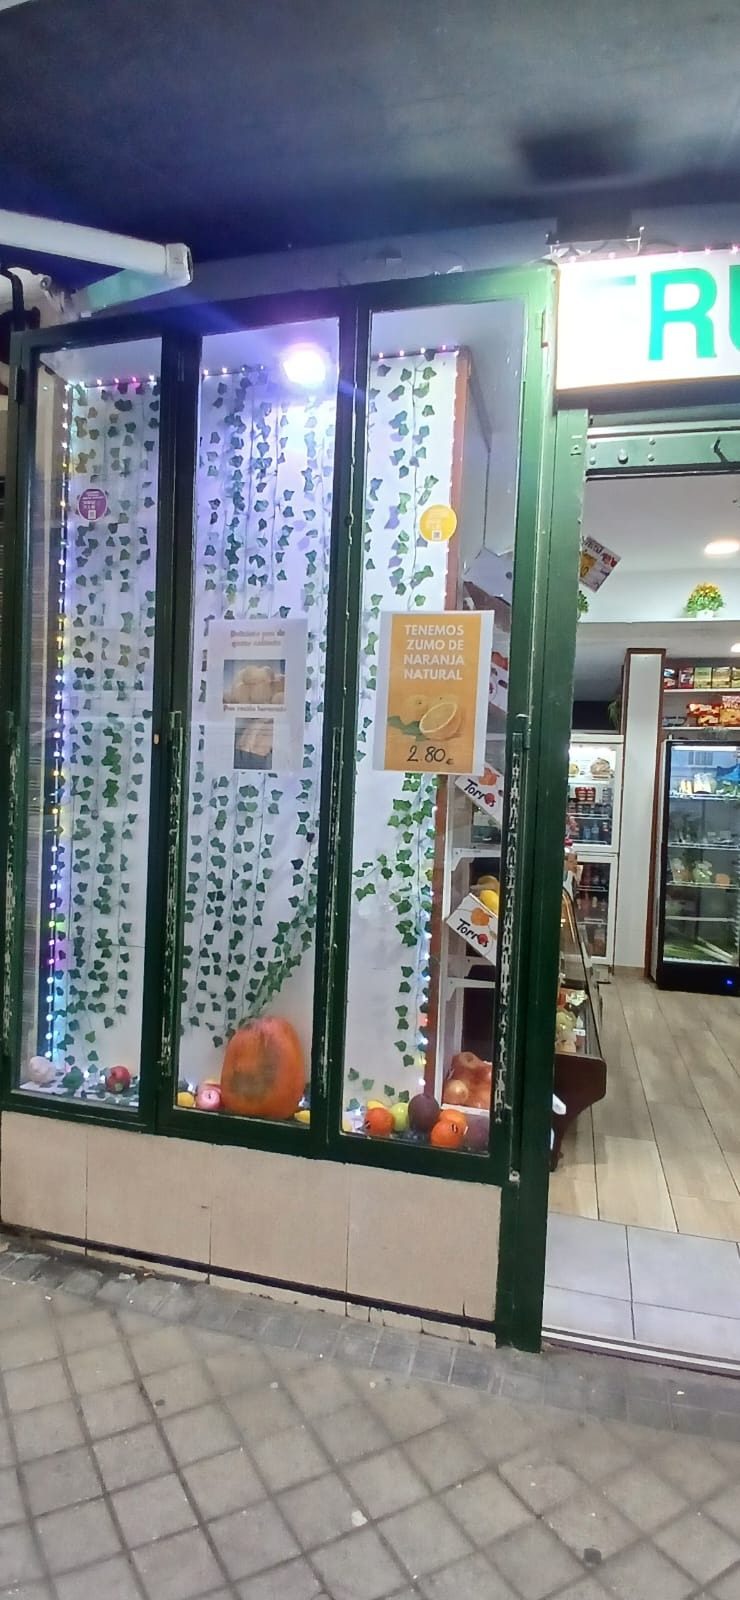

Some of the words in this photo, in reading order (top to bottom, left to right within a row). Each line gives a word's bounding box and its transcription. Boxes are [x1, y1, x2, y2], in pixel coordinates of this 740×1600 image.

[404, 624, 464, 636] TENEMOS
[406, 639, 445, 651] ZUMO
[448, 639, 464, 651] DE
[403, 654, 464, 666] NARANJA
[403, 669, 463, 681] NATURAL
